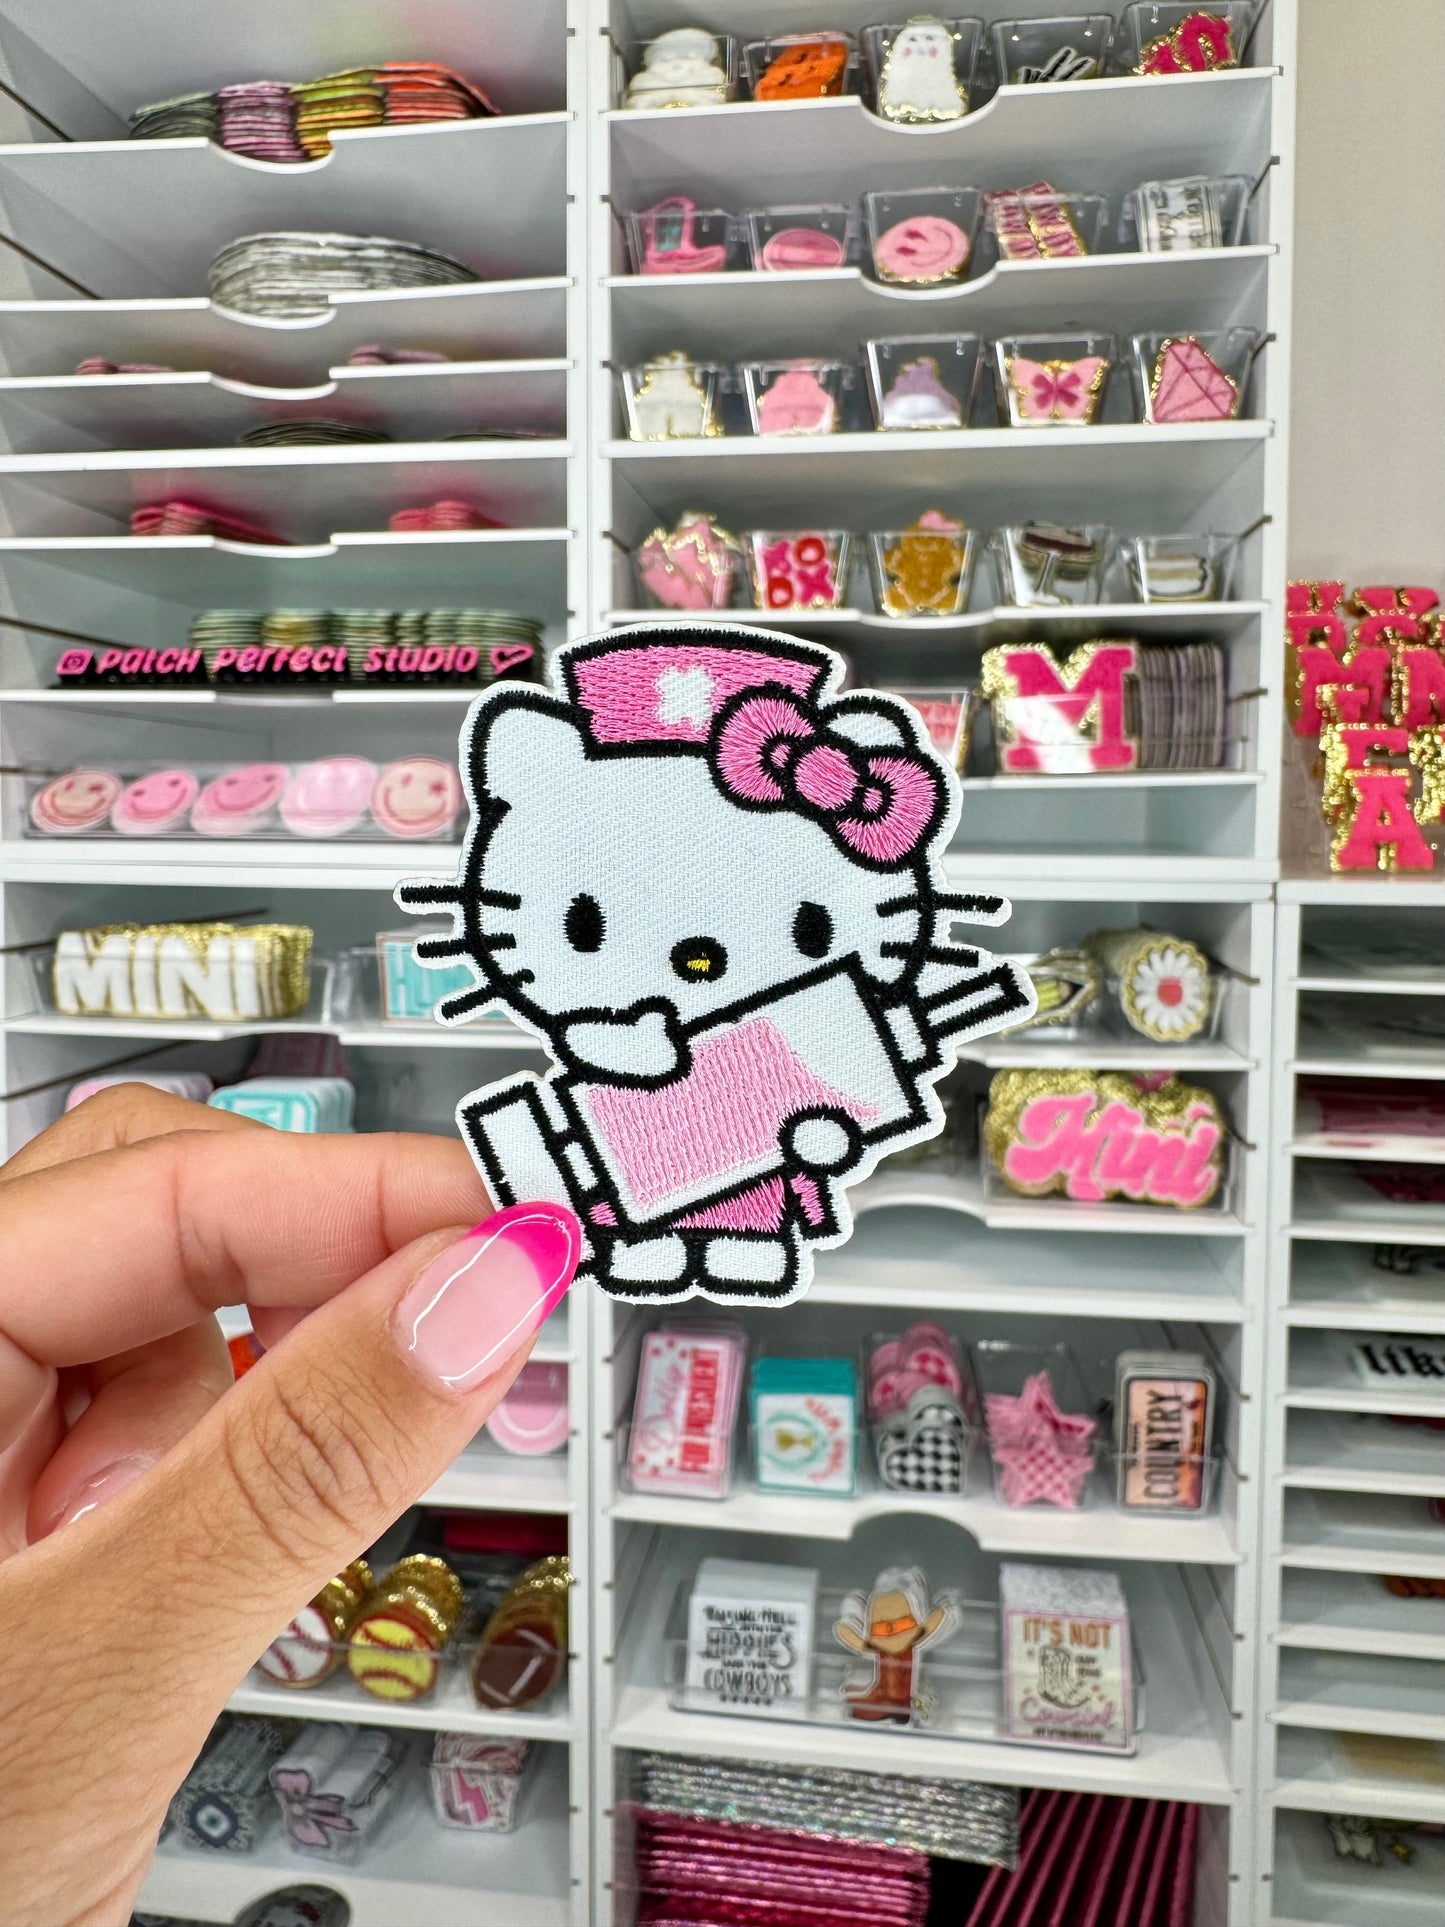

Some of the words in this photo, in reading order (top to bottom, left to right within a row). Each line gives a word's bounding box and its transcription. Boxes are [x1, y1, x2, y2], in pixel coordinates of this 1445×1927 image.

[1004, 645, 1134, 769] M
[1338, 774, 1434, 870] A
[56, 931, 262, 1019] MINI
[1005, 1091, 1218, 1205] Mini
[1144, 1389, 1182, 1499] COUNTRY
[1022, 1617, 1063, 1647] IT'S
[1069, 1621, 1111, 1650] NOT
[703, 1667, 793, 1697] COWBOYS
